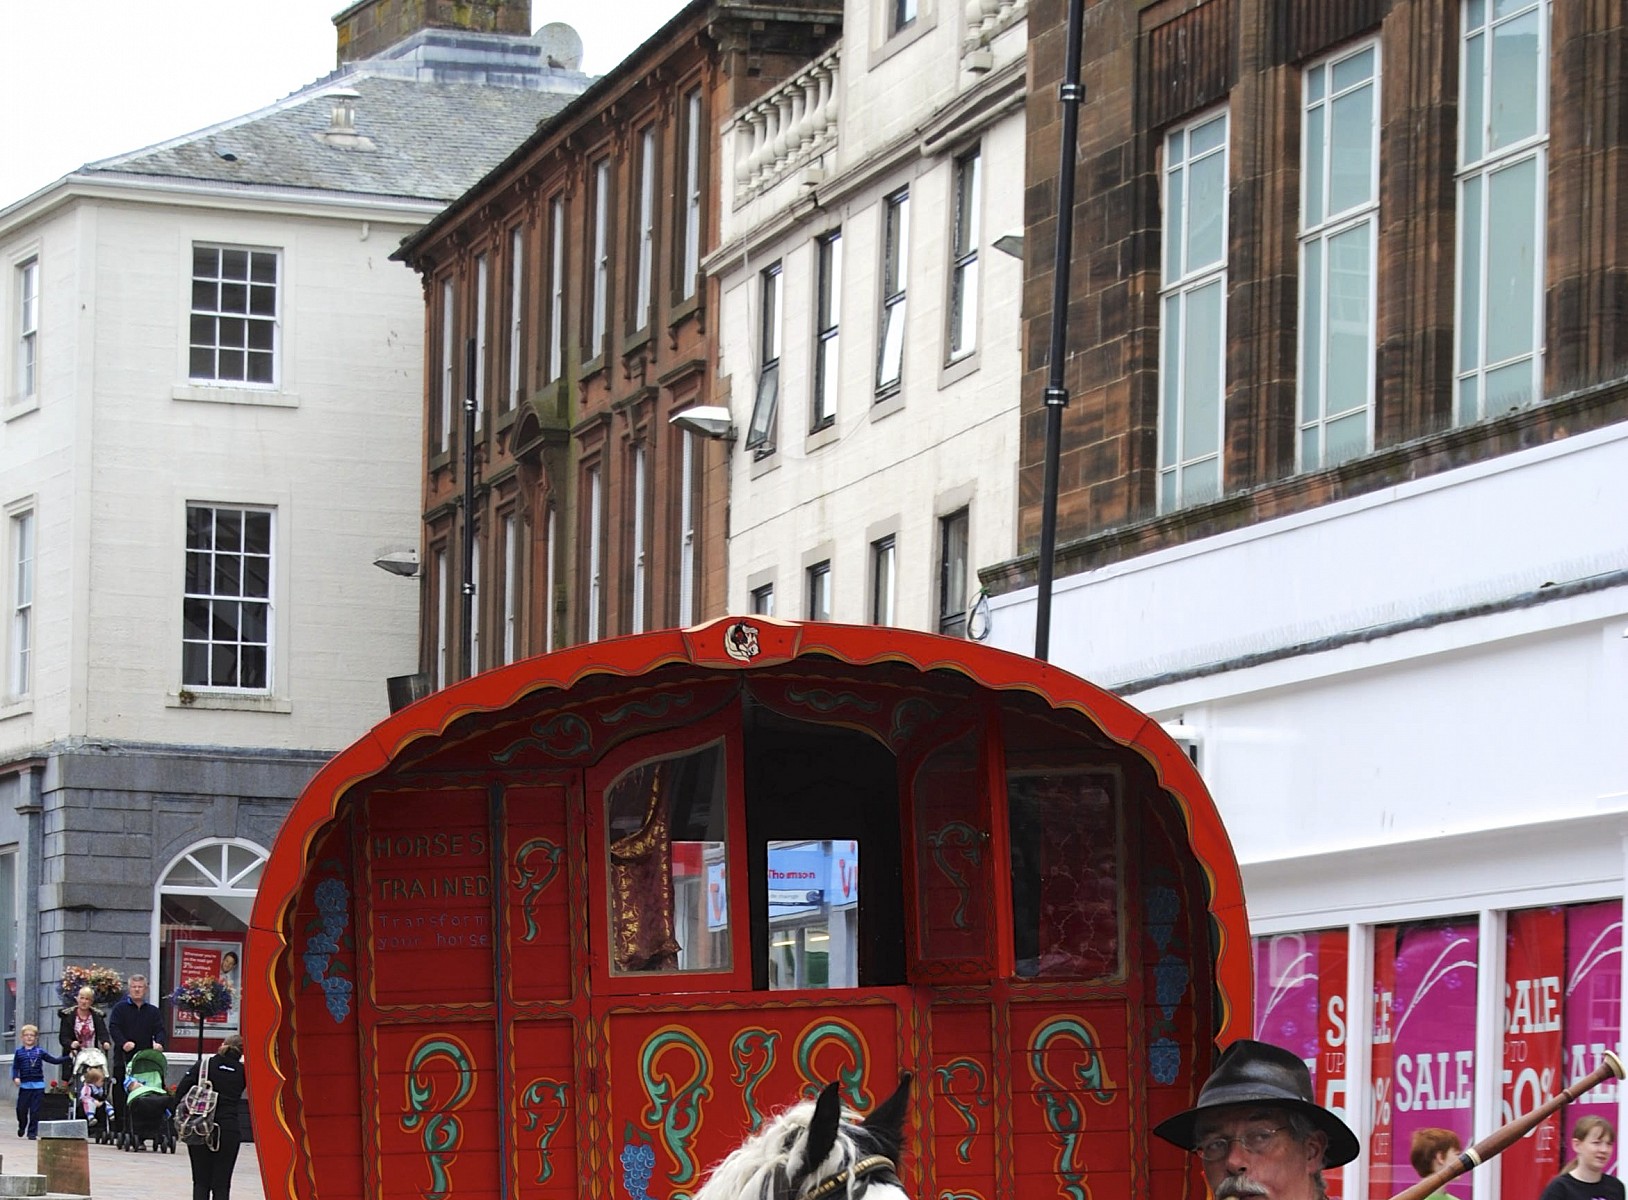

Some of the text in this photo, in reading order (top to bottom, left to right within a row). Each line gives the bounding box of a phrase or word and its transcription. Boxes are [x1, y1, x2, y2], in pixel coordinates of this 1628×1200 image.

[373, 831, 486, 858] HORSES
[768, 869, 816, 879] Thomson
[376, 875, 490, 901] TRAINED
[377, 931, 488, 950] your horse
[1395, 1050, 1474, 1112] SALE
